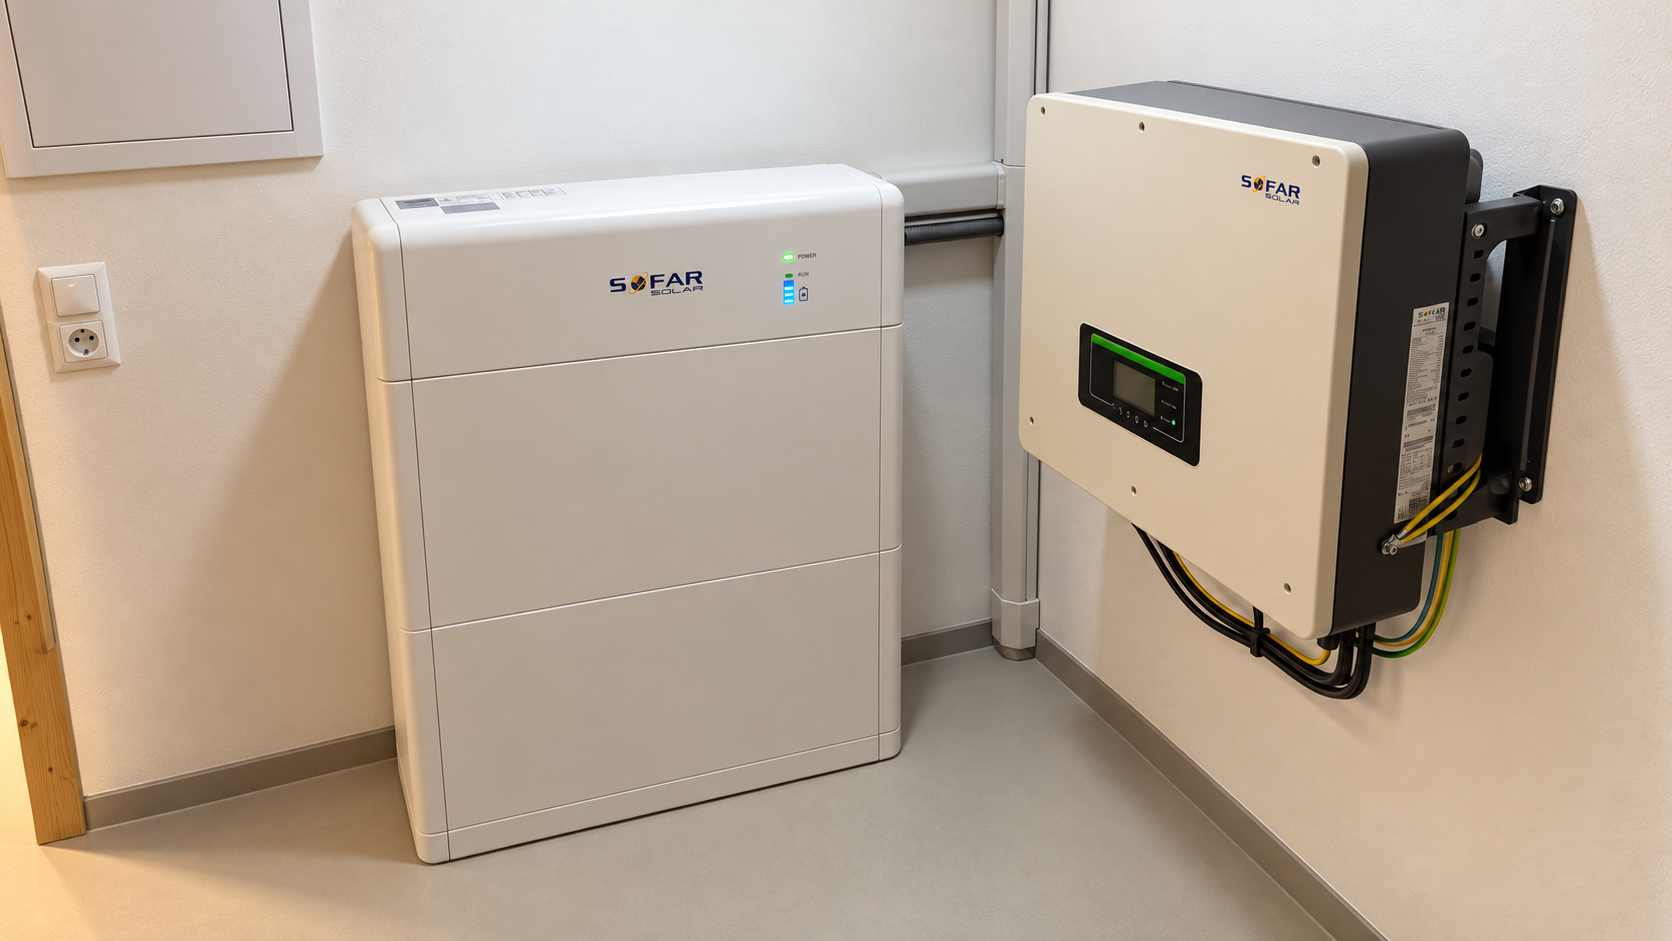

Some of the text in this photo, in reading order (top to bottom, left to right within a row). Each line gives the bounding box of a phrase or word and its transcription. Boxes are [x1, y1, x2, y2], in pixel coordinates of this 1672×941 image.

[1241, 175, 1300, 199] SOFAR
[1265, 193, 1300, 206] SOLAR
[610, 270, 703, 295] SOFAR
[650, 285, 703, 296] SOLAR
